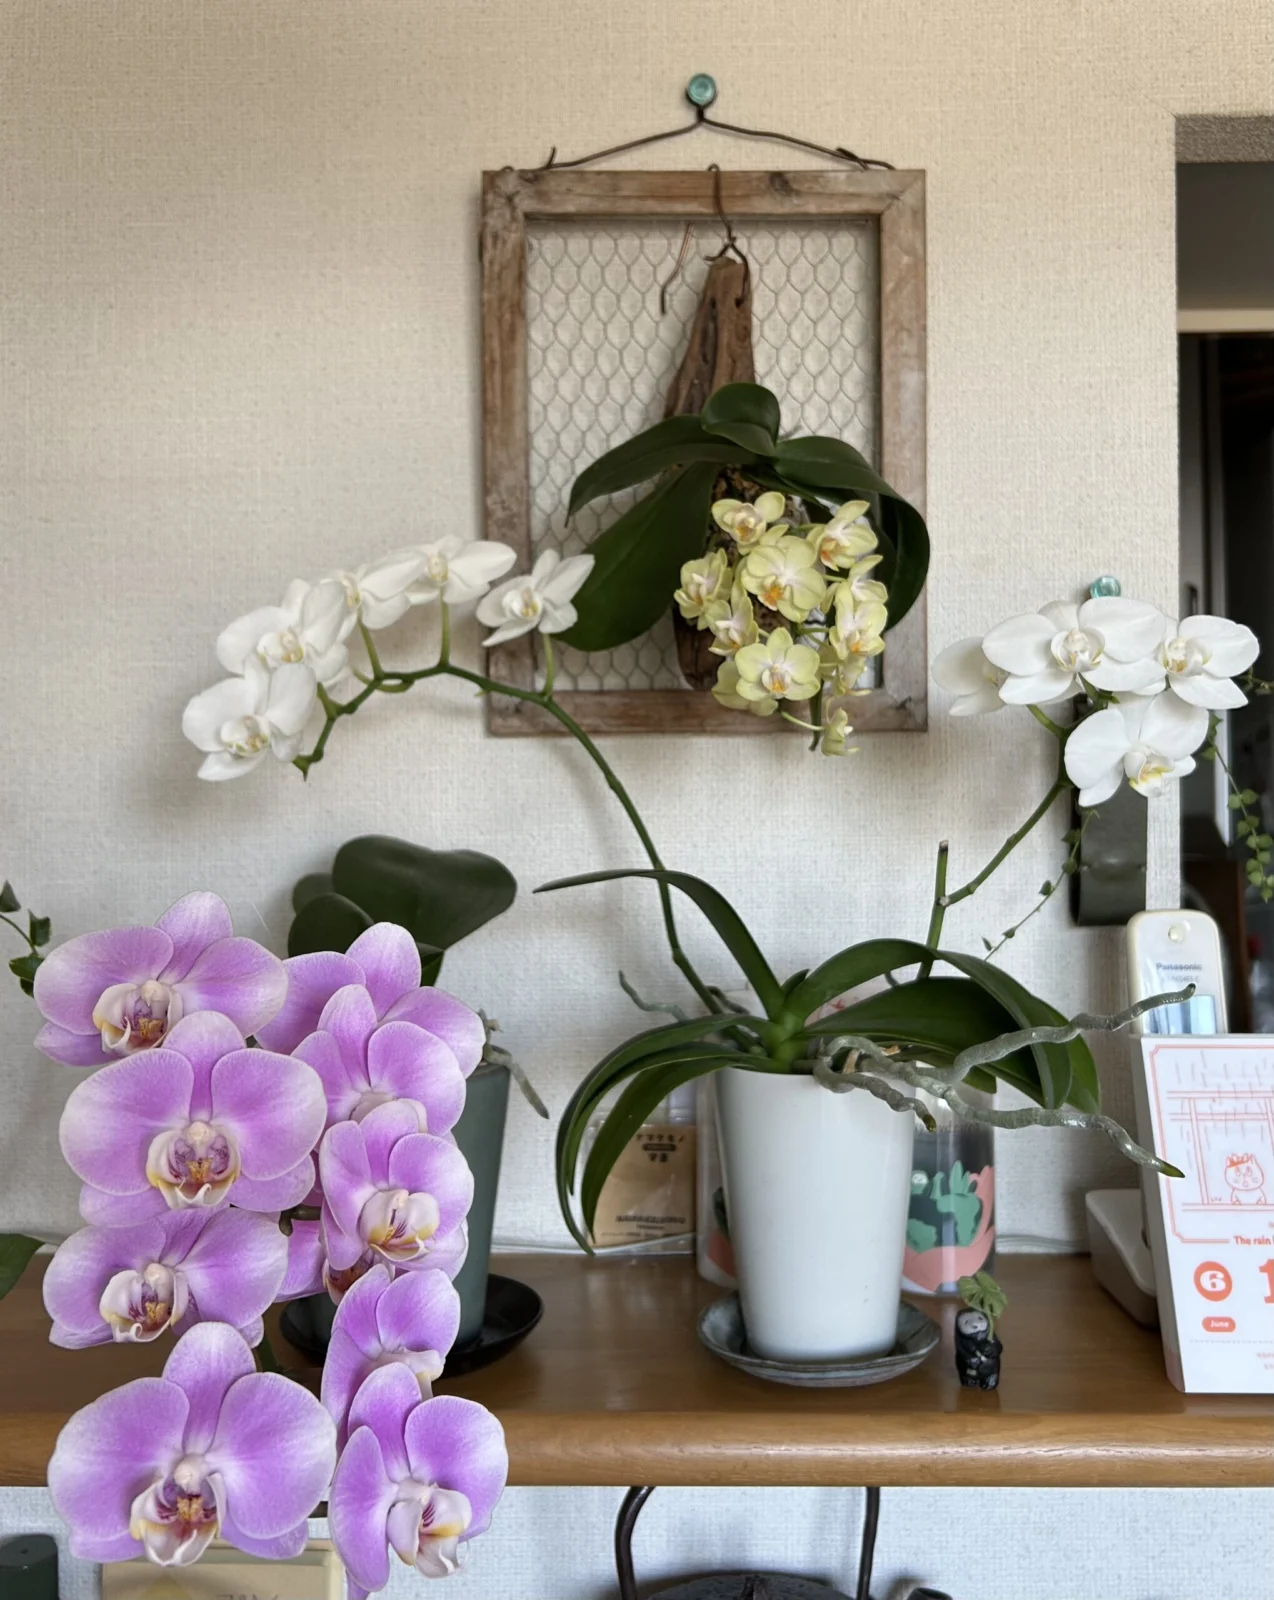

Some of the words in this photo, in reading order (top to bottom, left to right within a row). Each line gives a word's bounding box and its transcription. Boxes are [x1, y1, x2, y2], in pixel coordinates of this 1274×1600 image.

[1156, 962, 1203, 971] Panasonic
[1234, 1235, 1251, 1245] The
[1253, 1234, 1271, 1245] rain
[1200, 1270, 1226, 1292] 6
[1210, 1320, 1229, 1328] June
